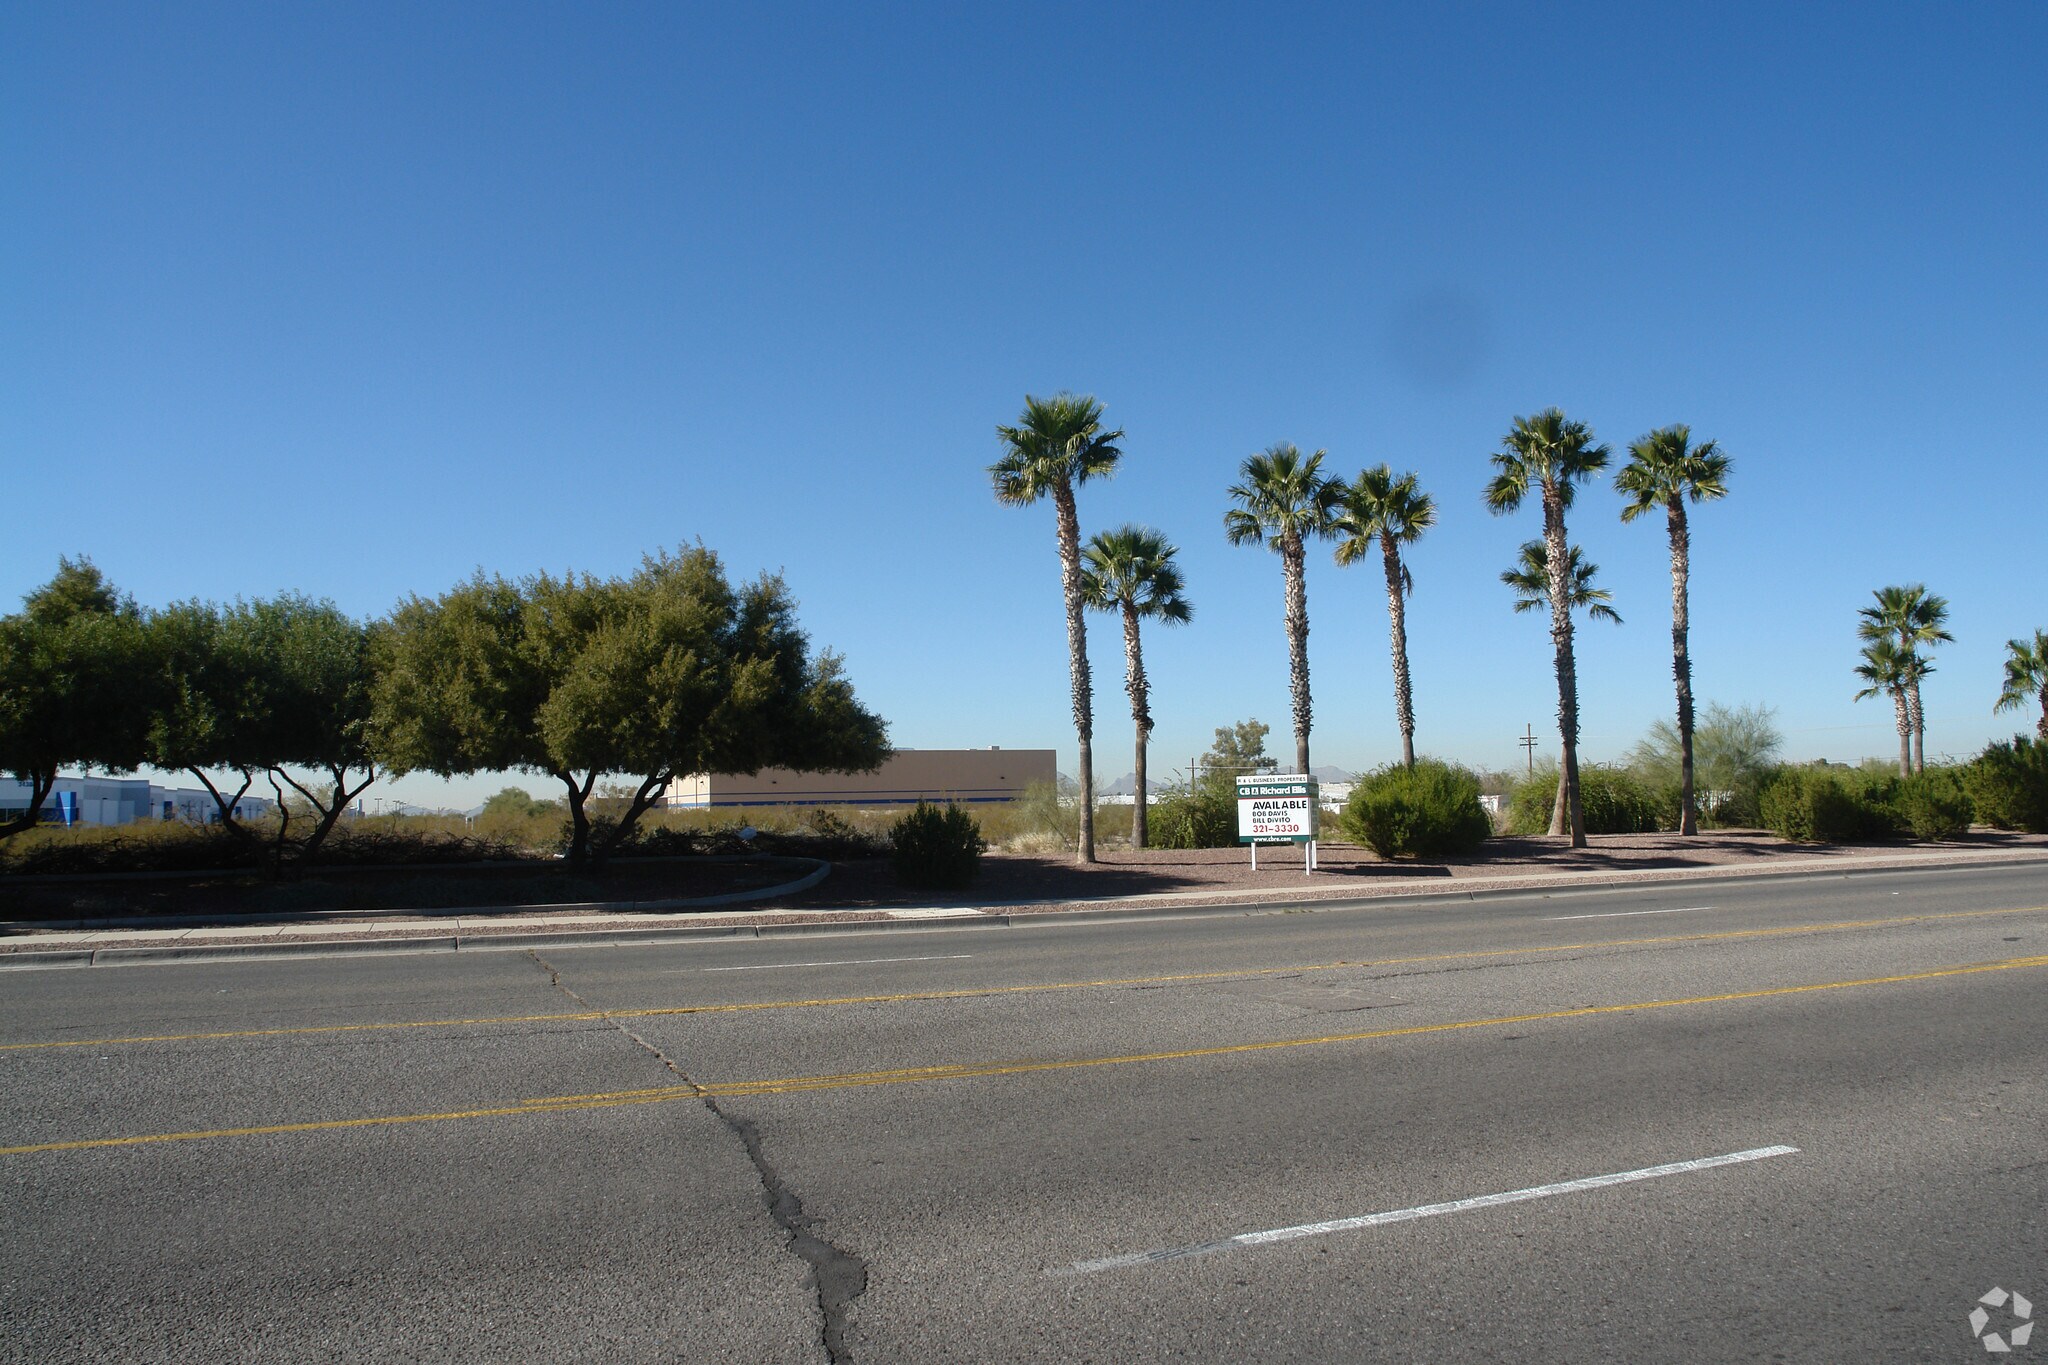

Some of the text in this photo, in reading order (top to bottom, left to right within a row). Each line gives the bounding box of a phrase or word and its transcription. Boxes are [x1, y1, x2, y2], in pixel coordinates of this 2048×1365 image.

[1239, 787, 1250, 795] CB
[1260, 786, 1290, 794] Richard
[1253, 800, 1307, 809] AVAILABLE
[1253, 824, 1299, 832] 321-3330
